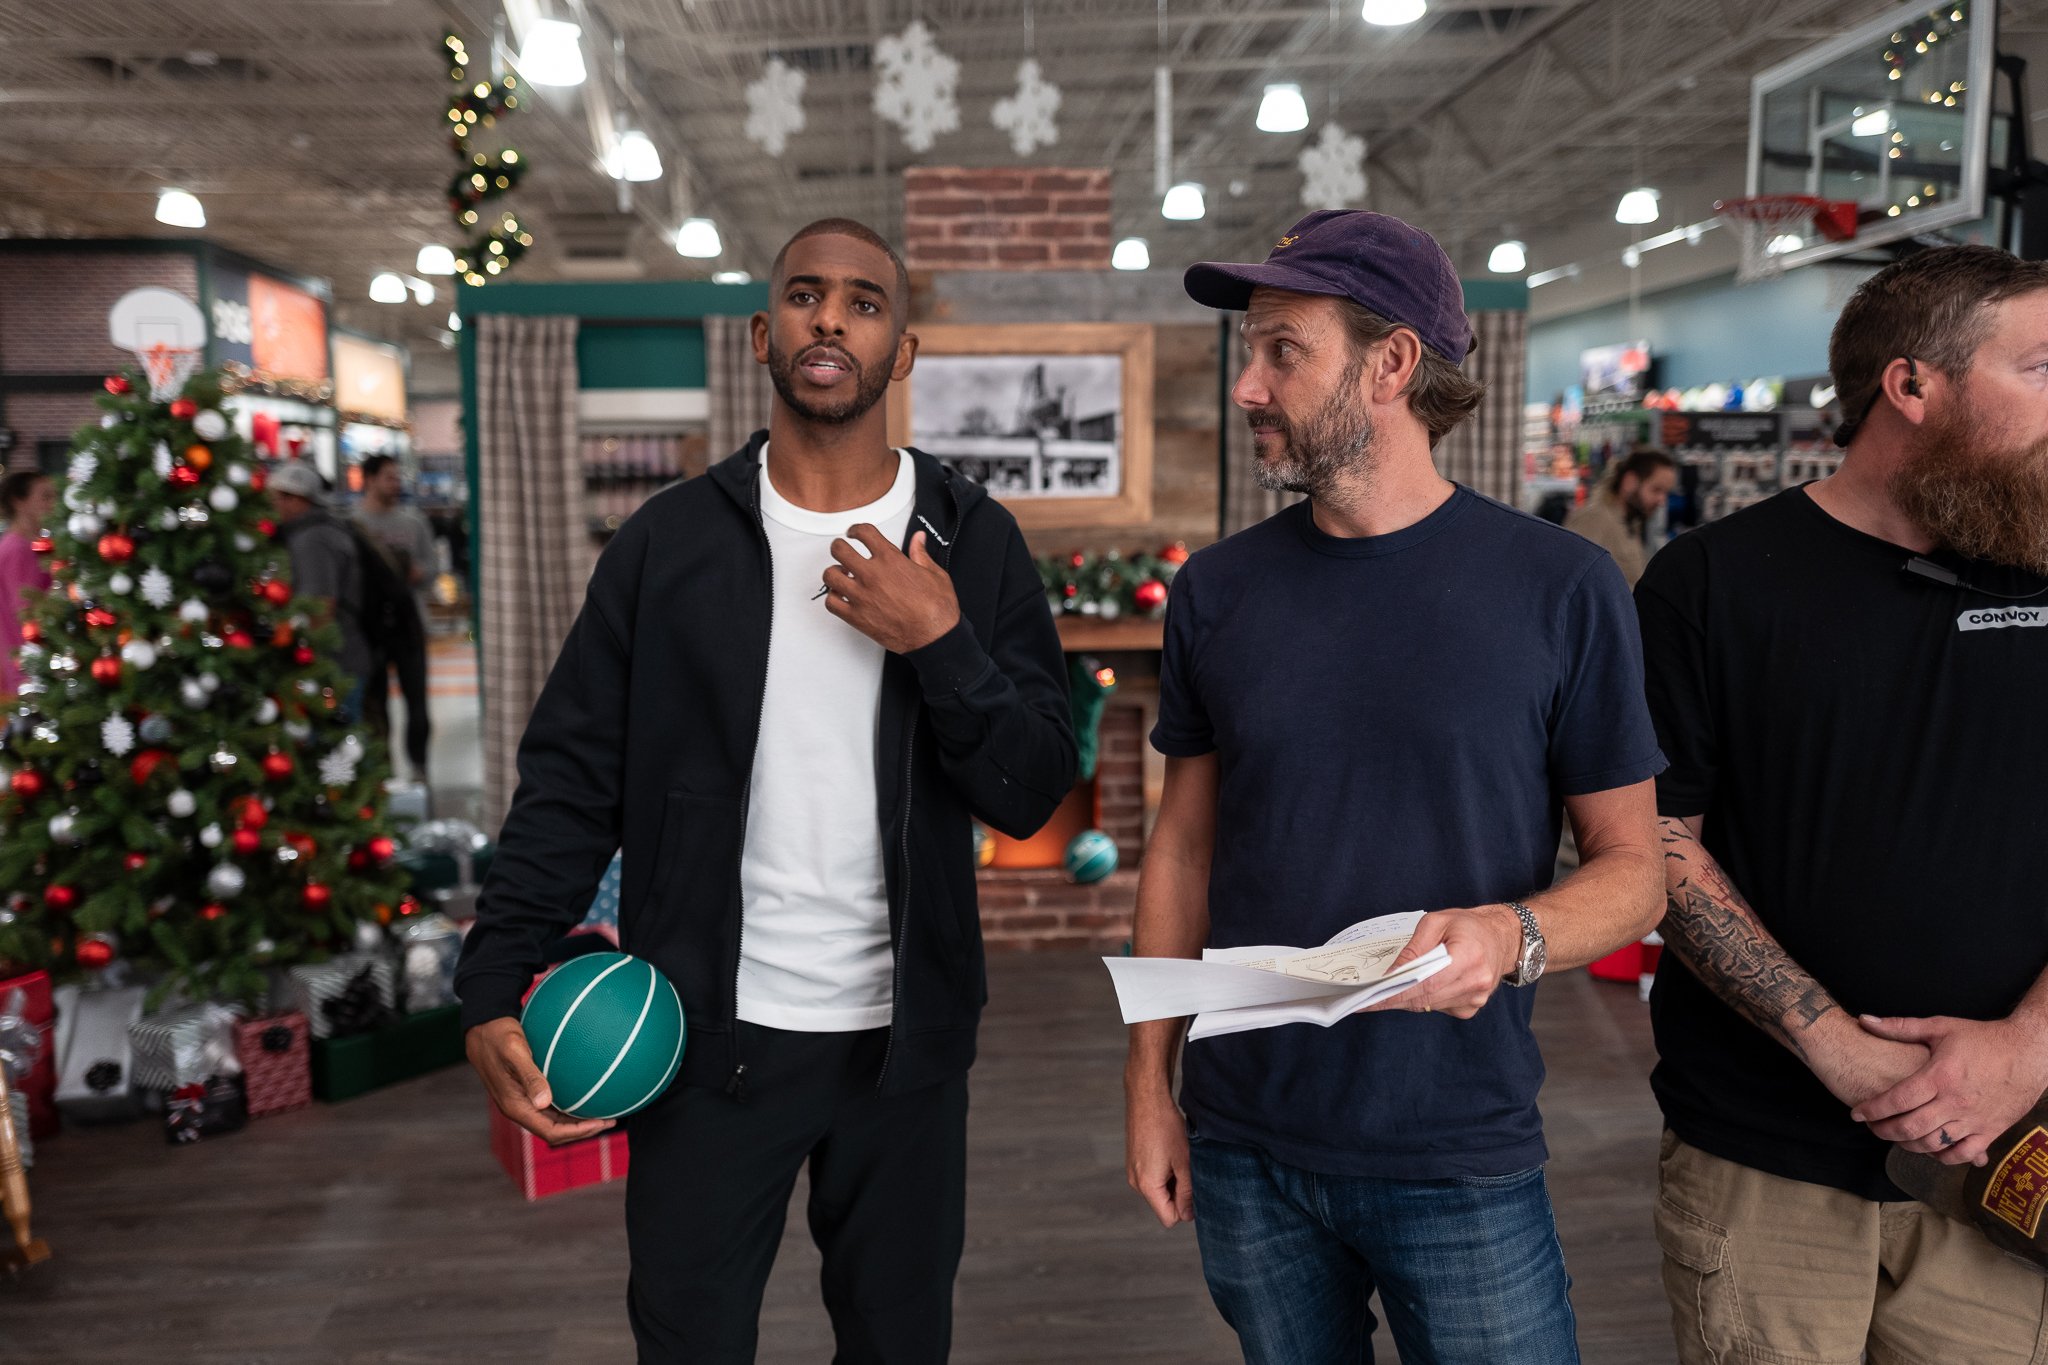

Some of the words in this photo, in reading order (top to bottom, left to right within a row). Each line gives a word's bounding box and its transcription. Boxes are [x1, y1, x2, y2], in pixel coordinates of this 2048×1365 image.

[1969, 610, 2040, 625] CONVOY
[2013, 1143, 2032, 1163] NEW
[1991, 1163, 2012, 1198] MEXICO
